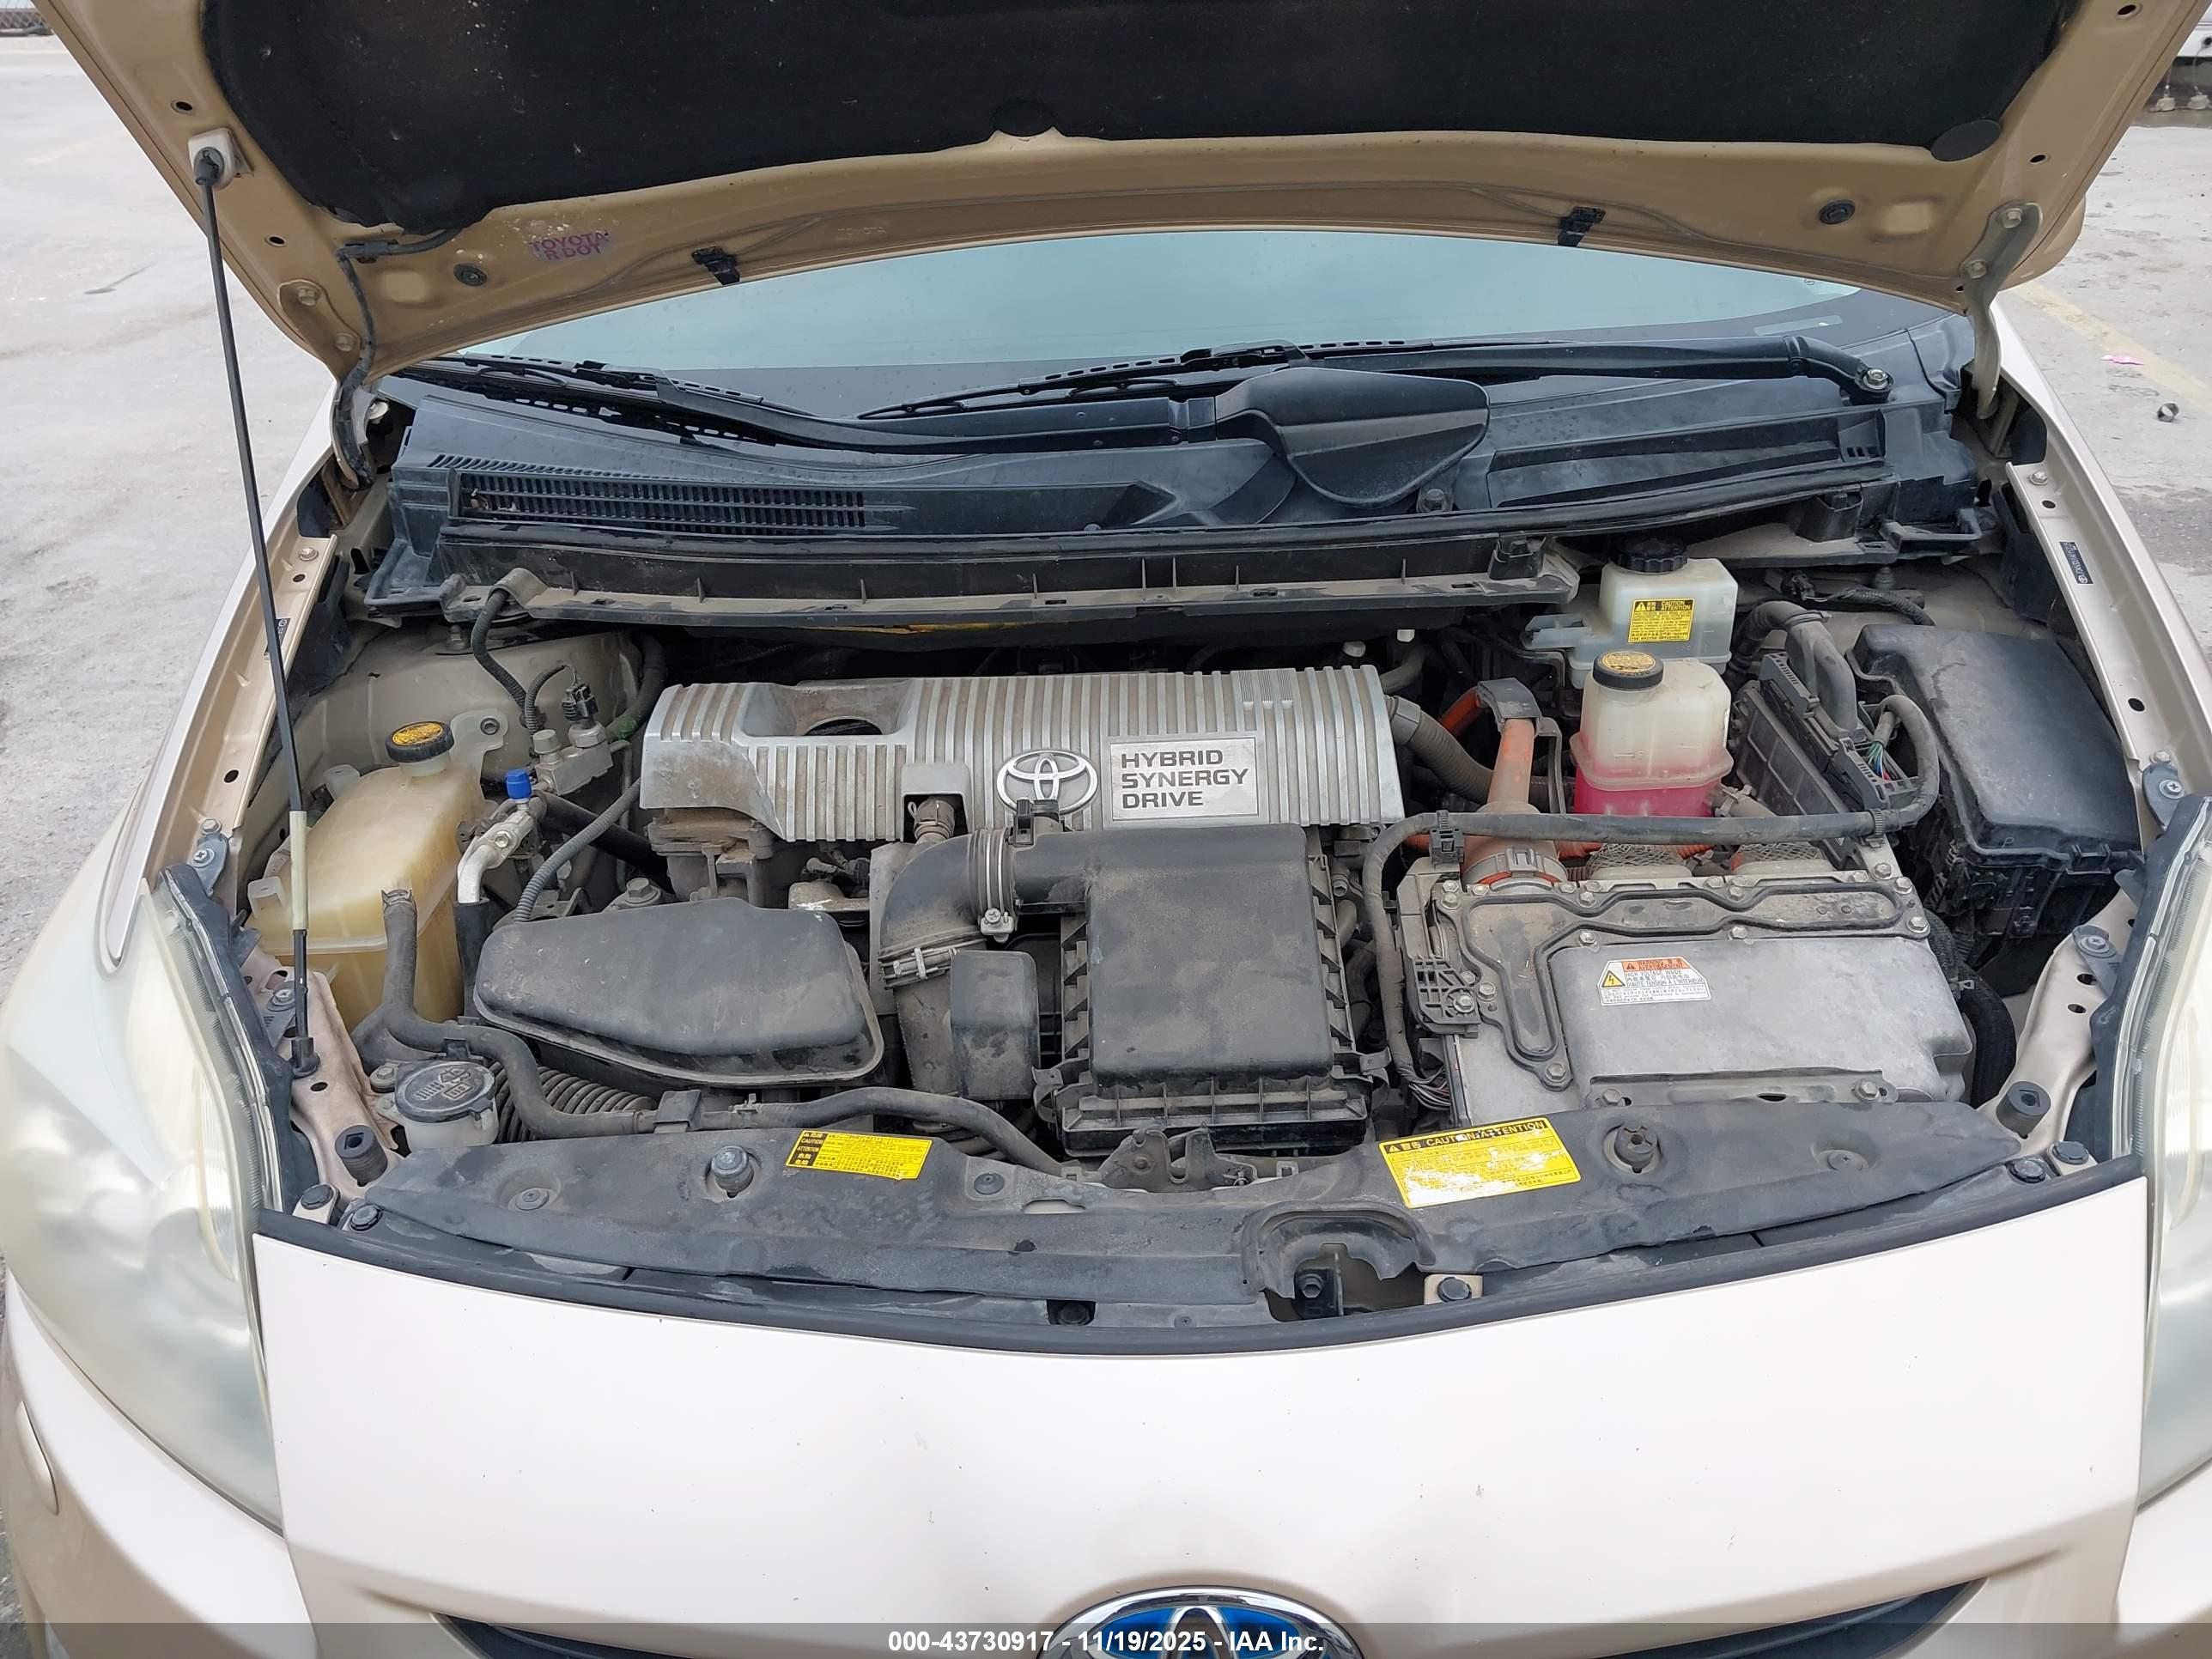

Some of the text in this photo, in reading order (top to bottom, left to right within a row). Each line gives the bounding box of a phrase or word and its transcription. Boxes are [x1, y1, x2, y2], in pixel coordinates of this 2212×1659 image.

[528, 232, 609, 252] TOYOTA
[562, 243, 601, 258] DOT
[1121, 750, 1223, 769] HYBRID
[1121, 769, 1249, 789] SYNERGY
[1122, 791, 1204, 809] DRIVE
